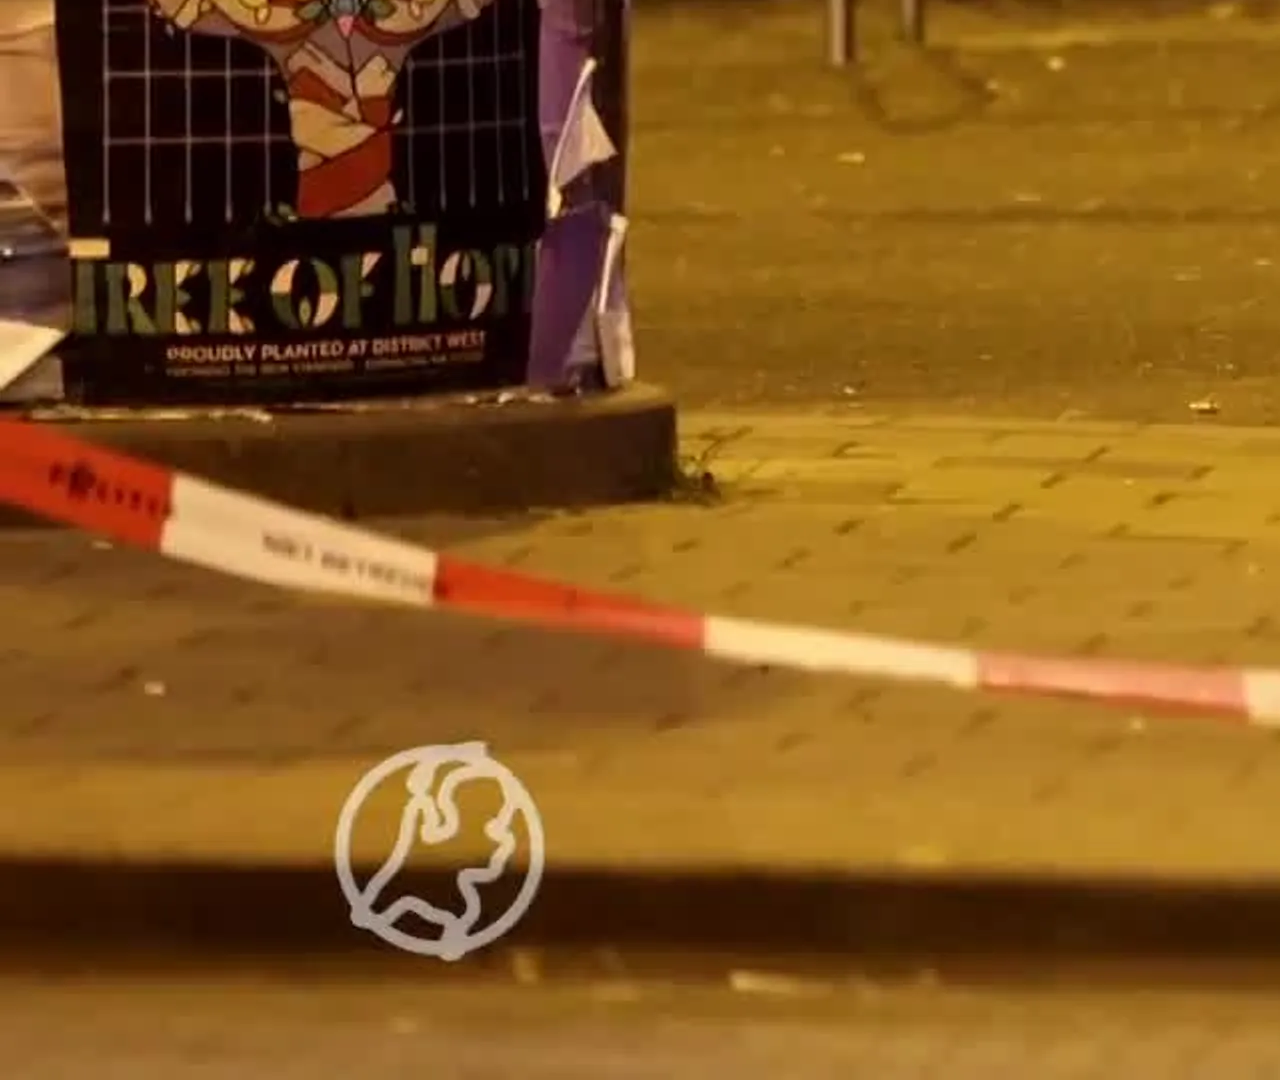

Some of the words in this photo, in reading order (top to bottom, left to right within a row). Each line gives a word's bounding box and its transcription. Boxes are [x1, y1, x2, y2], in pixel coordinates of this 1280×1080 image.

[68, 237, 256, 335] TREE
[269, 251, 383, 329] OF
[166, 343, 256, 363] PROUDLY
[261, 336, 344, 361] PLANTED
[347, 337, 368, 357] AT
[446, 329, 486, 349] WEST
